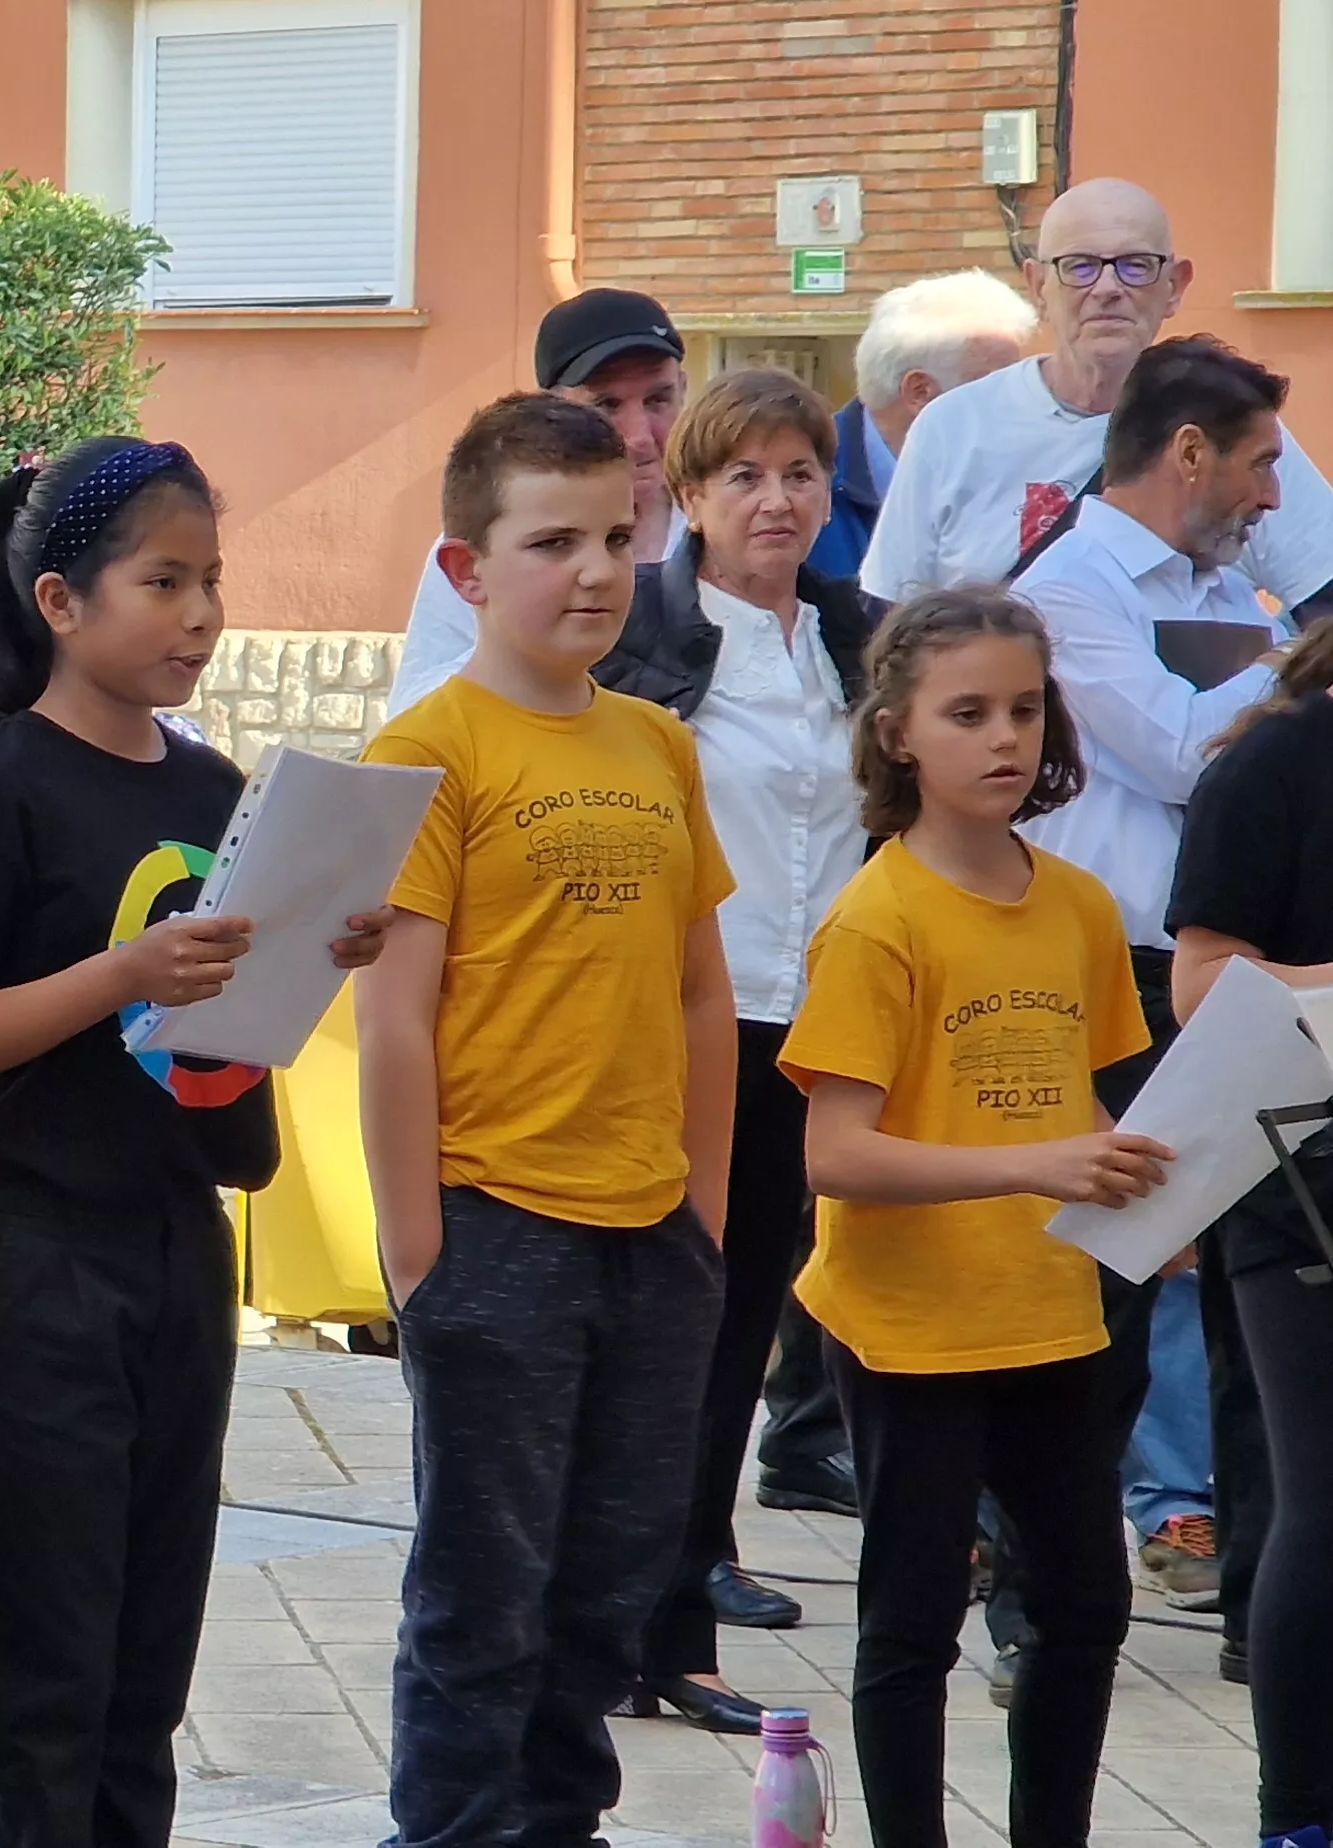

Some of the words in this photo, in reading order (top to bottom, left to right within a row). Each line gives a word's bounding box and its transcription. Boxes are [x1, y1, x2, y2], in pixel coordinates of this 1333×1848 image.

[515, 791, 575, 829] CORO
[579, 789, 674, 825] ESCOLAR
[561, 882, 600, 902] PIO
[608, 882, 641, 901] XII
[944, 994, 1002, 1034] CORO
[977, 1089, 1021, 1108] PIO
[1027, 1087, 1063, 1107] XII
